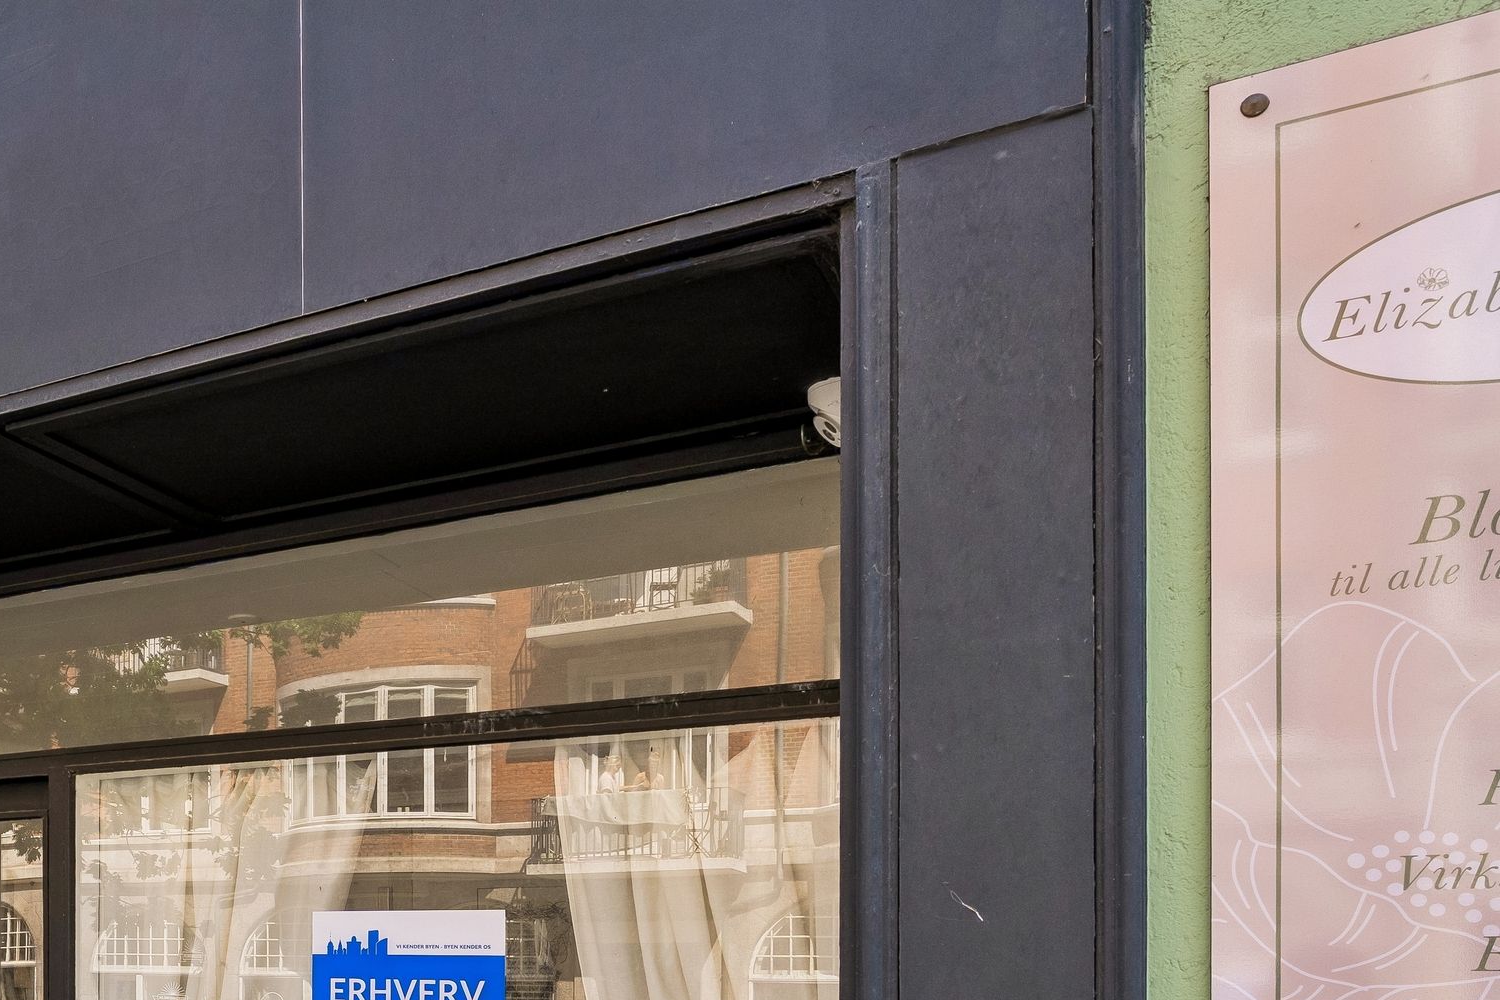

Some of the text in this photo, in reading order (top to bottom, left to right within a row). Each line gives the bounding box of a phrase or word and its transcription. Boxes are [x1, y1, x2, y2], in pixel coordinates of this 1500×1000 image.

[1329, 562, 1373, 597] til
[1387, 554, 1461, 591] alle
[1400, 852, 1500, 892] Virk
